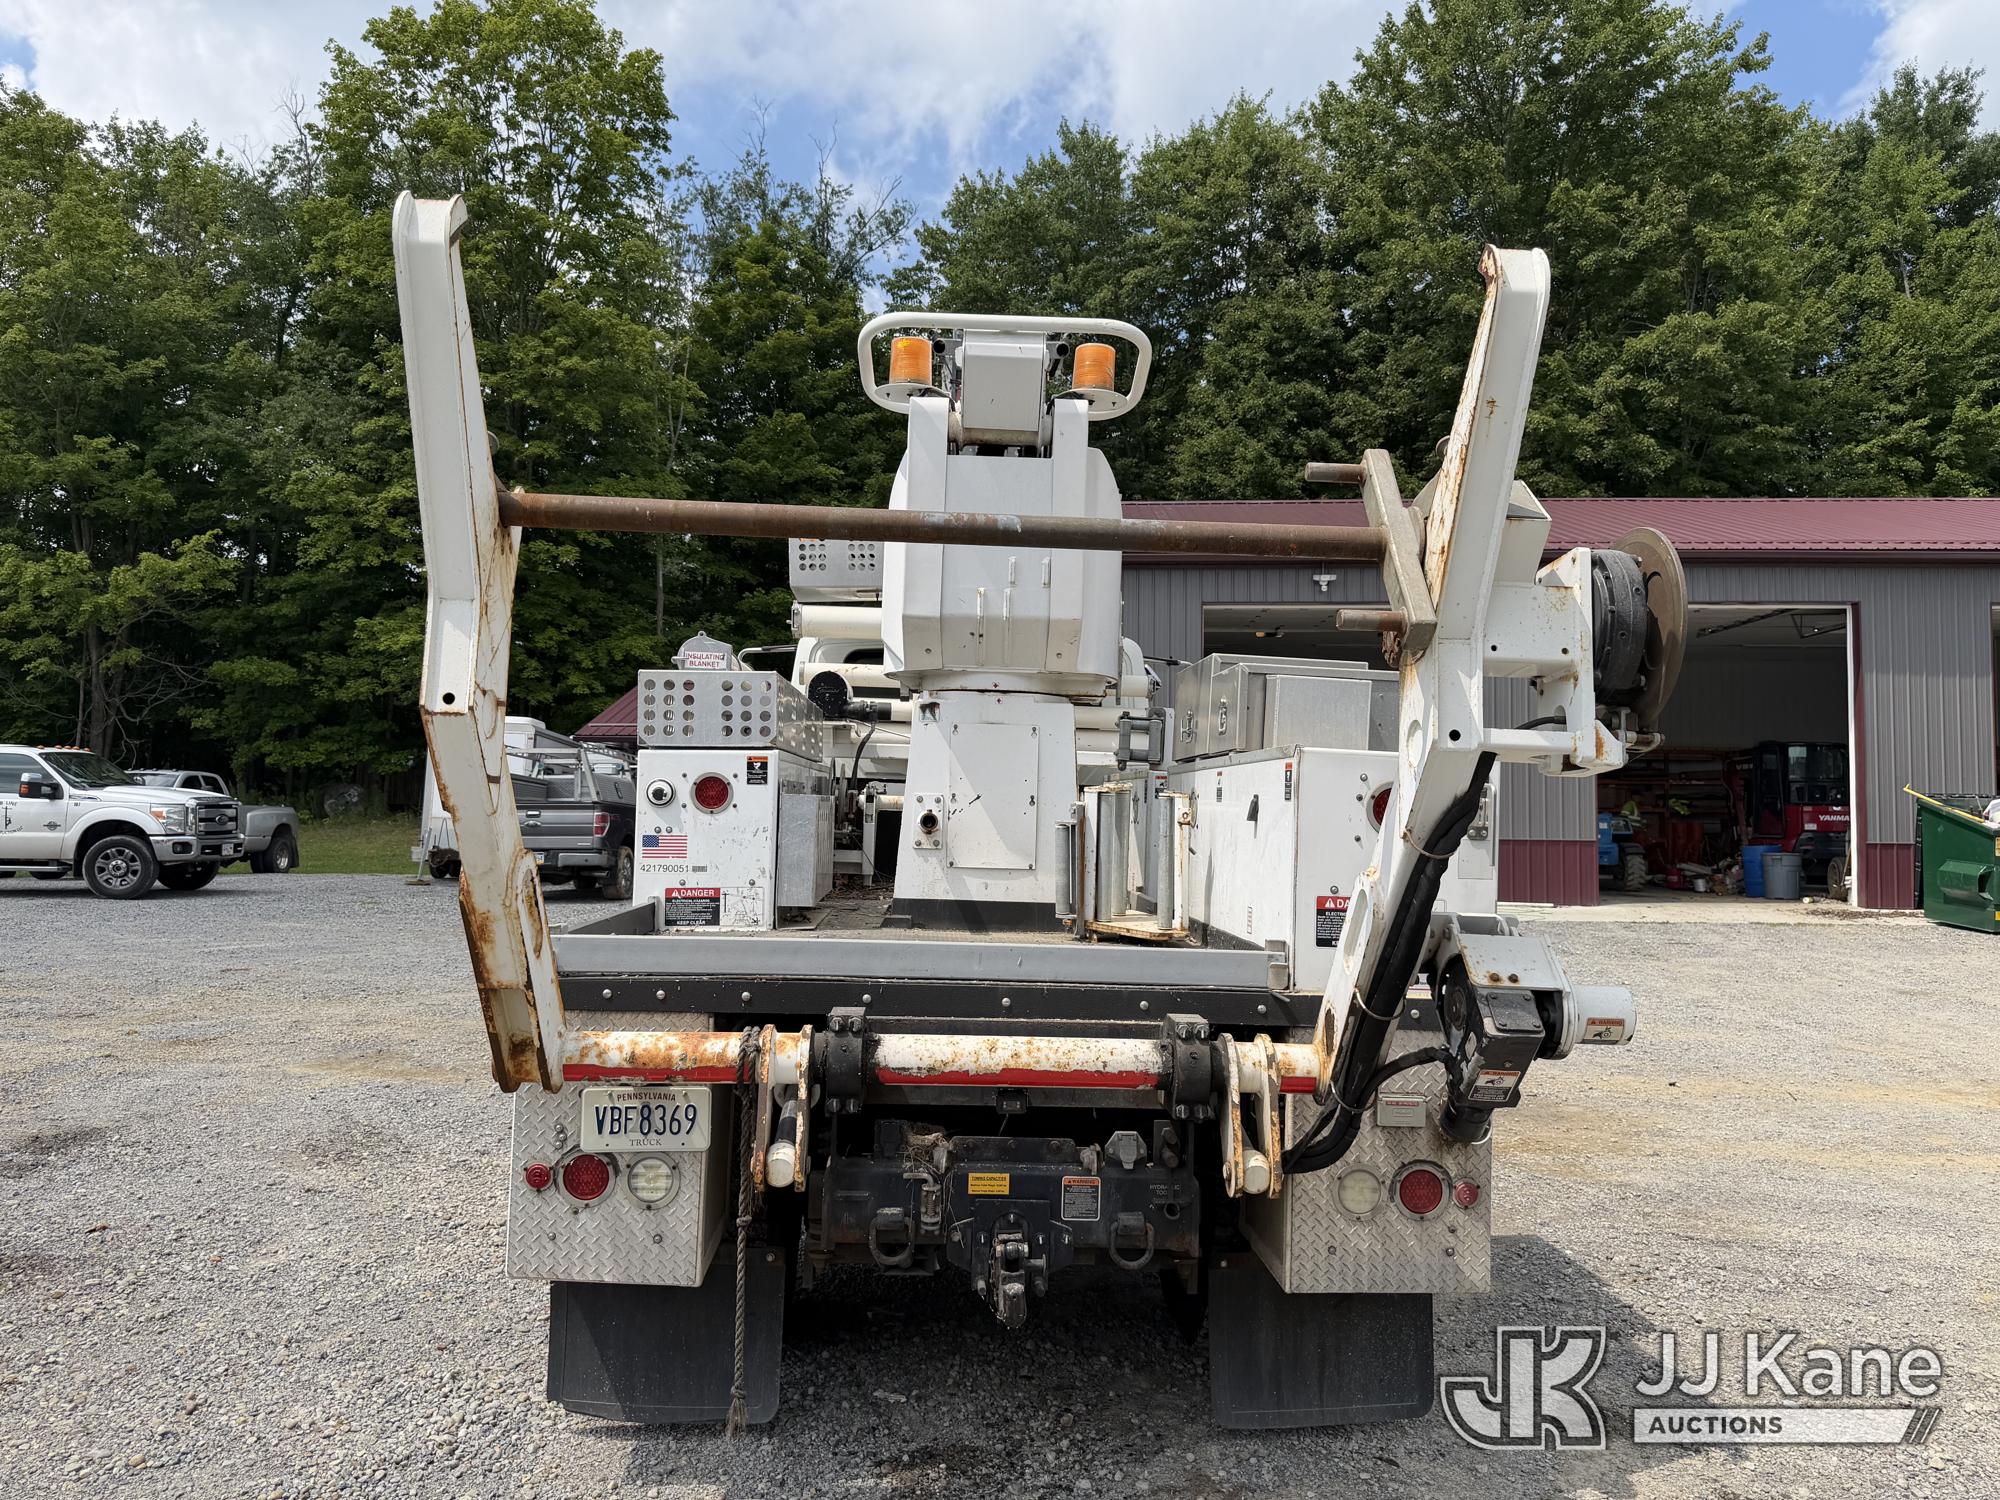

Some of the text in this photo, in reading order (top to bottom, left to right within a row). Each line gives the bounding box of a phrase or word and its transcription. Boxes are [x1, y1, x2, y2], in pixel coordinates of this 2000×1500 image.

[686, 652, 725, 660] INSULATING
[640, 864, 689, 872] 421790051
[680, 889, 715, 897] DANGER
[617, 1092, 676, 1102] PENNSYLVANIA
[595, 1104, 697, 1135] VBF8369
